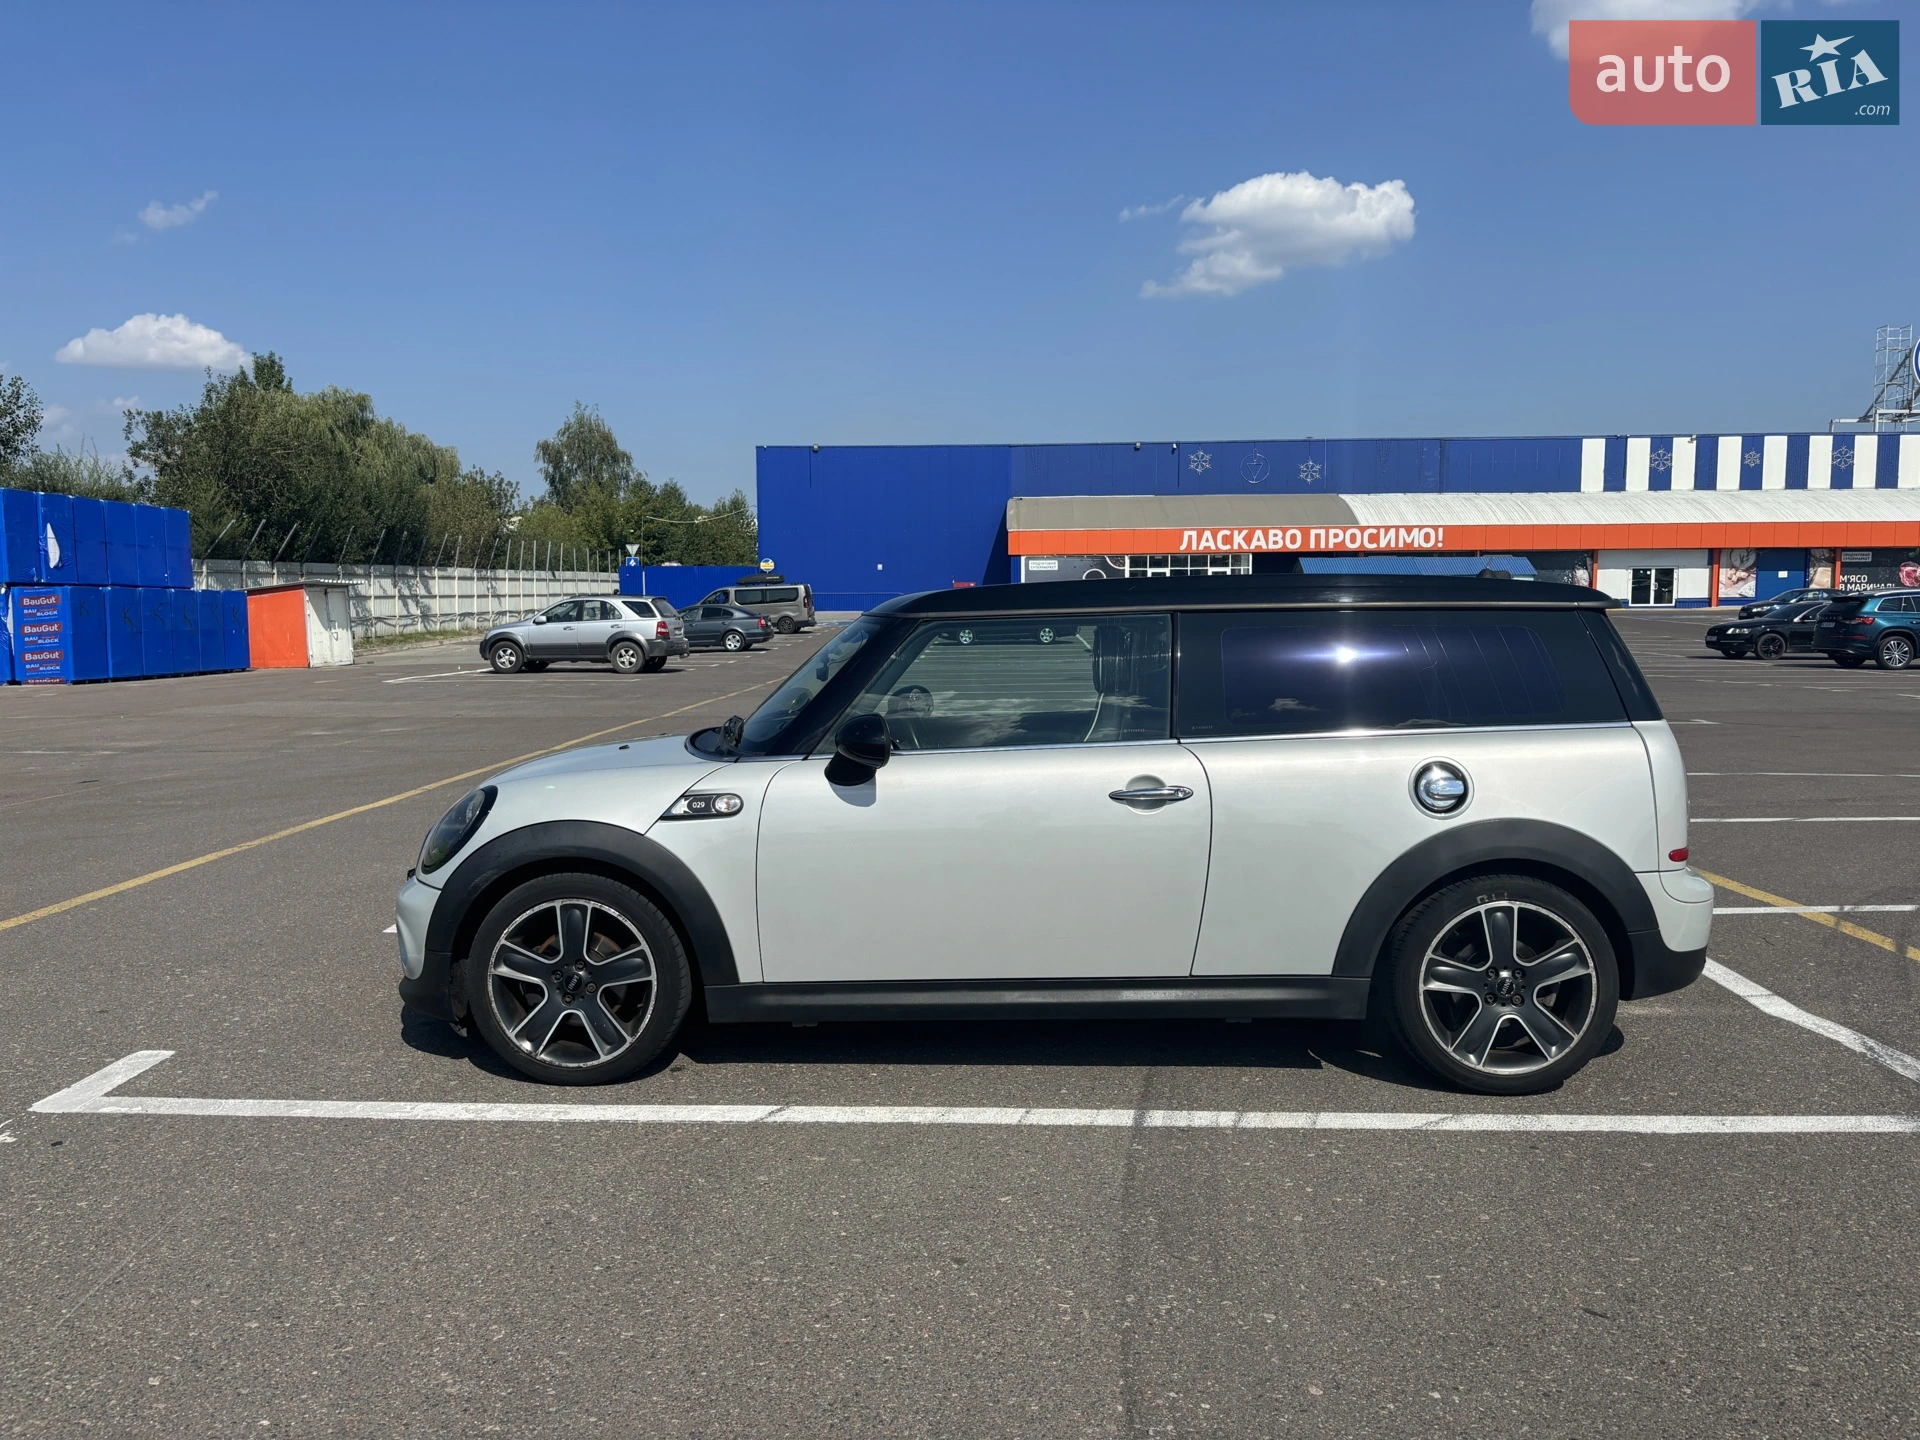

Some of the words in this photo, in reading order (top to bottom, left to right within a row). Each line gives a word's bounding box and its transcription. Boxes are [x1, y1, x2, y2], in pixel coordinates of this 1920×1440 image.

[1180, 529, 1302, 550] ЛАСКАВО
[1310, 528, 1444, 549] ПРОСИМО!
[23, 596, 56, 606] BauGut
[24, 623, 58, 633] BauGut
[25, 651, 59, 661] BauGut
